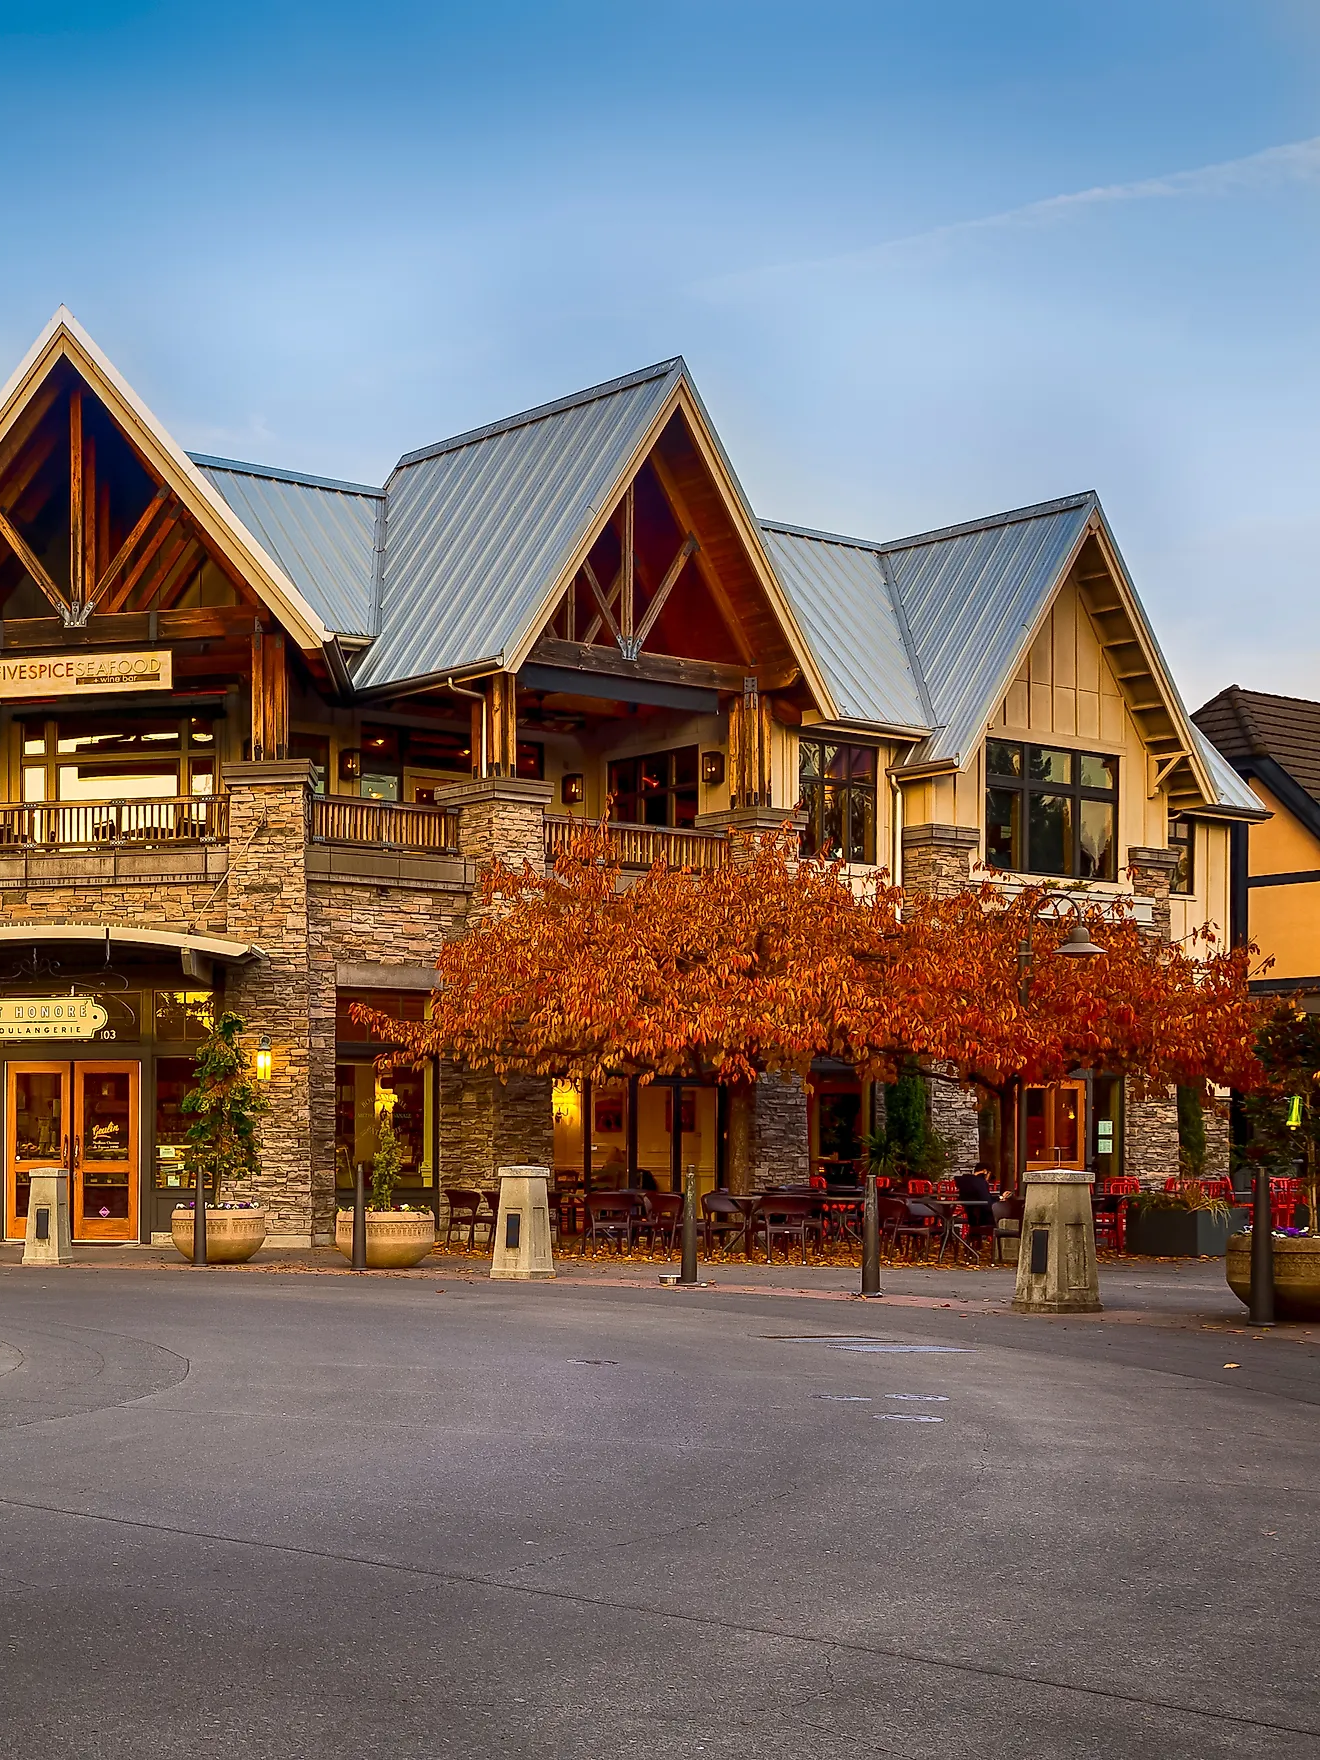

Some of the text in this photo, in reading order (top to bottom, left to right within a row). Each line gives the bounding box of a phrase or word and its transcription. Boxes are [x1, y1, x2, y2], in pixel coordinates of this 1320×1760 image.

[100, 675, 121, 683] wine
[122, 674, 138, 682] bar
[14, 1000, 89, 1019] HONORÉ
